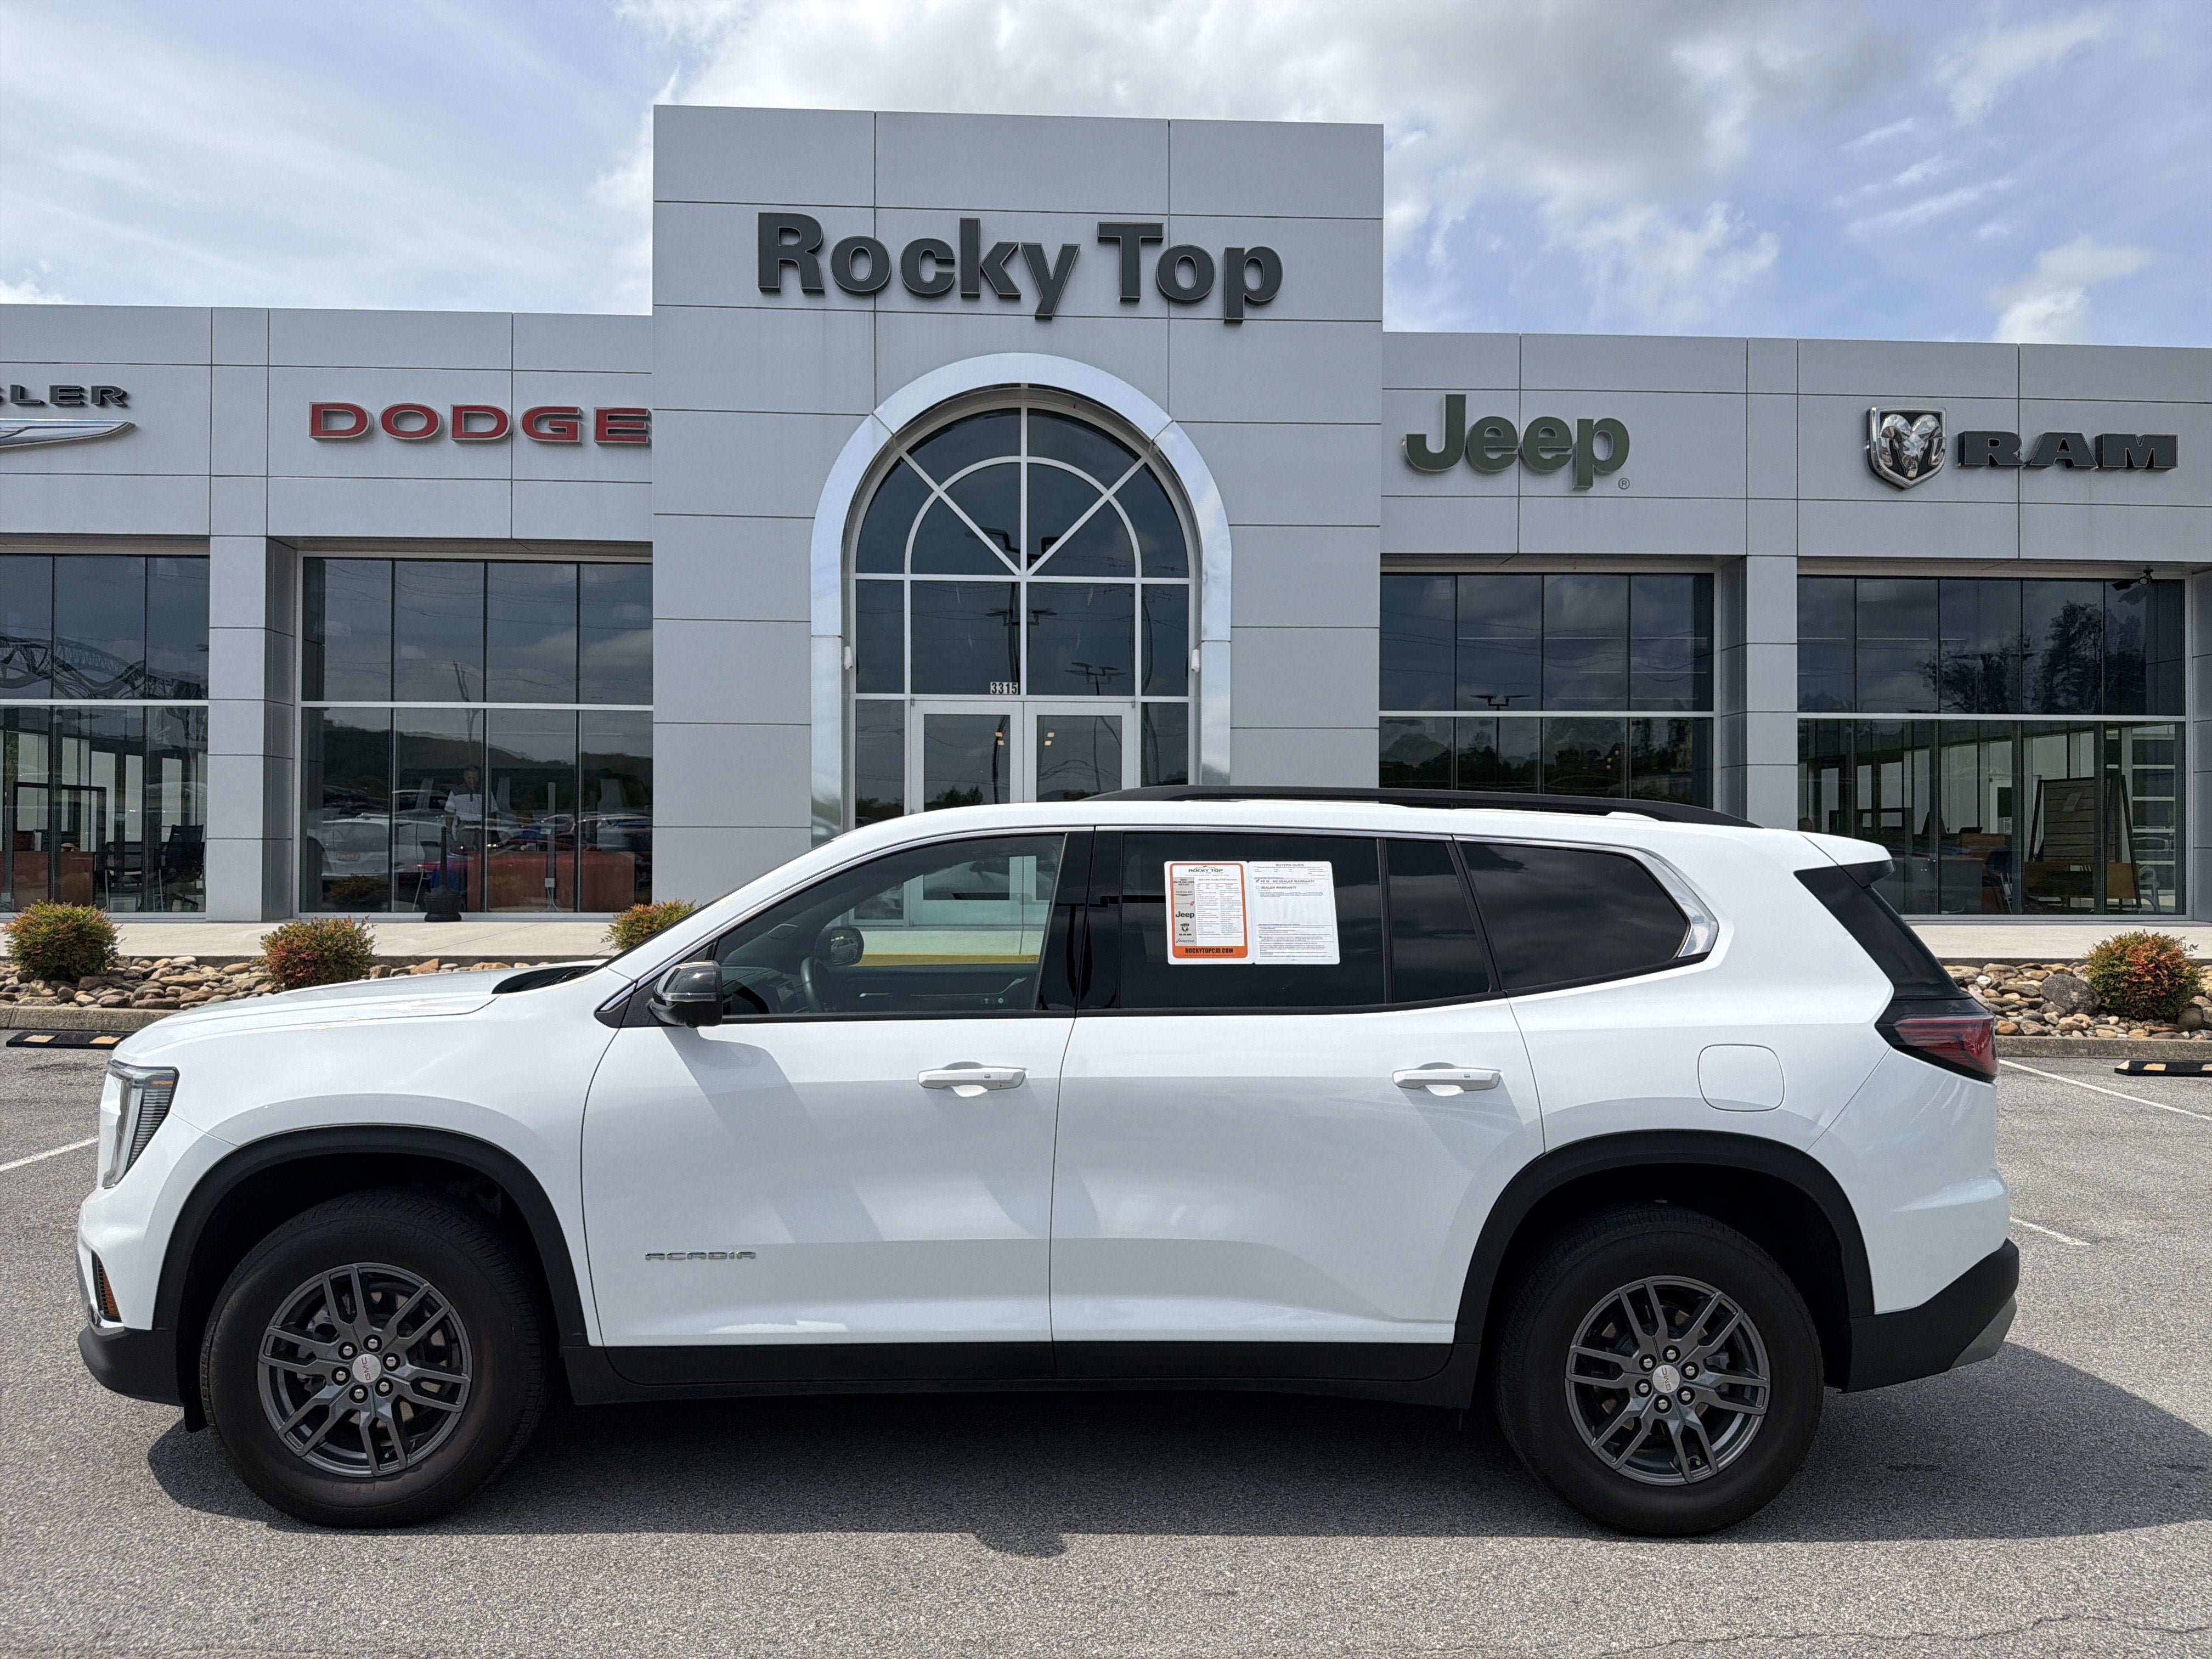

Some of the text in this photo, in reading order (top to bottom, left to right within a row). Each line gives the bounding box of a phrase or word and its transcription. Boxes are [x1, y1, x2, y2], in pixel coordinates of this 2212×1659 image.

[758, 212, 1283, 323] Rocky Top
[0, 384, 127, 406] LER
[309, 402, 652, 444] DODGE
[1403, 394, 1630, 490] Jeep
[1958, 431, 2178, 469] RAM
[991, 682, 1017, 694] 3315
[645, 1251, 756, 1261] ACADIA
[361, 1356, 371, 1381] GMC
[1662, 1367, 1672, 1391] GMC
